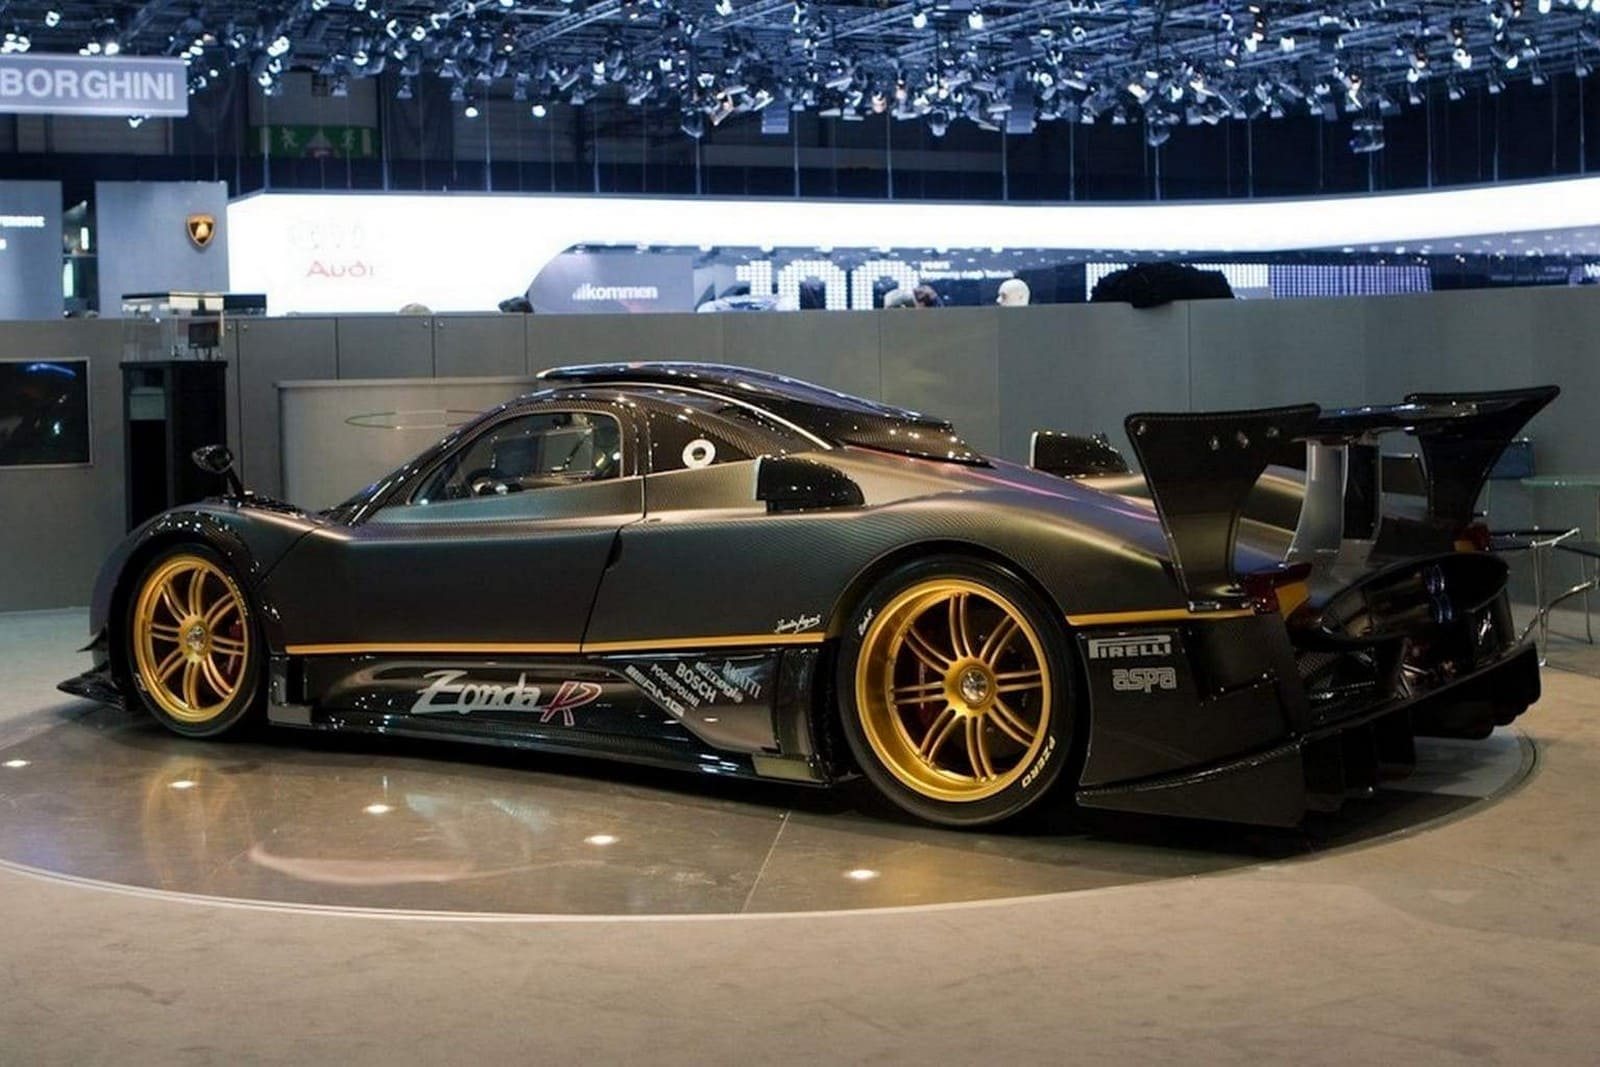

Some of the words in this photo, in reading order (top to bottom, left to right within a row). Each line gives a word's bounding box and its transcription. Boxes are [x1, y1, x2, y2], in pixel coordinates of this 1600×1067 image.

[0, 68, 175, 100] BORGHINI
[306, 260, 375, 278] Audi
[1088, 634, 1171, 659] PIRELLI
[676, 661, 717, 703] BOSCH
[1112, 667, 1176, 693] aspa
[410, 670, 543, 715] Zonda
[540, 681, 602, 726] R
